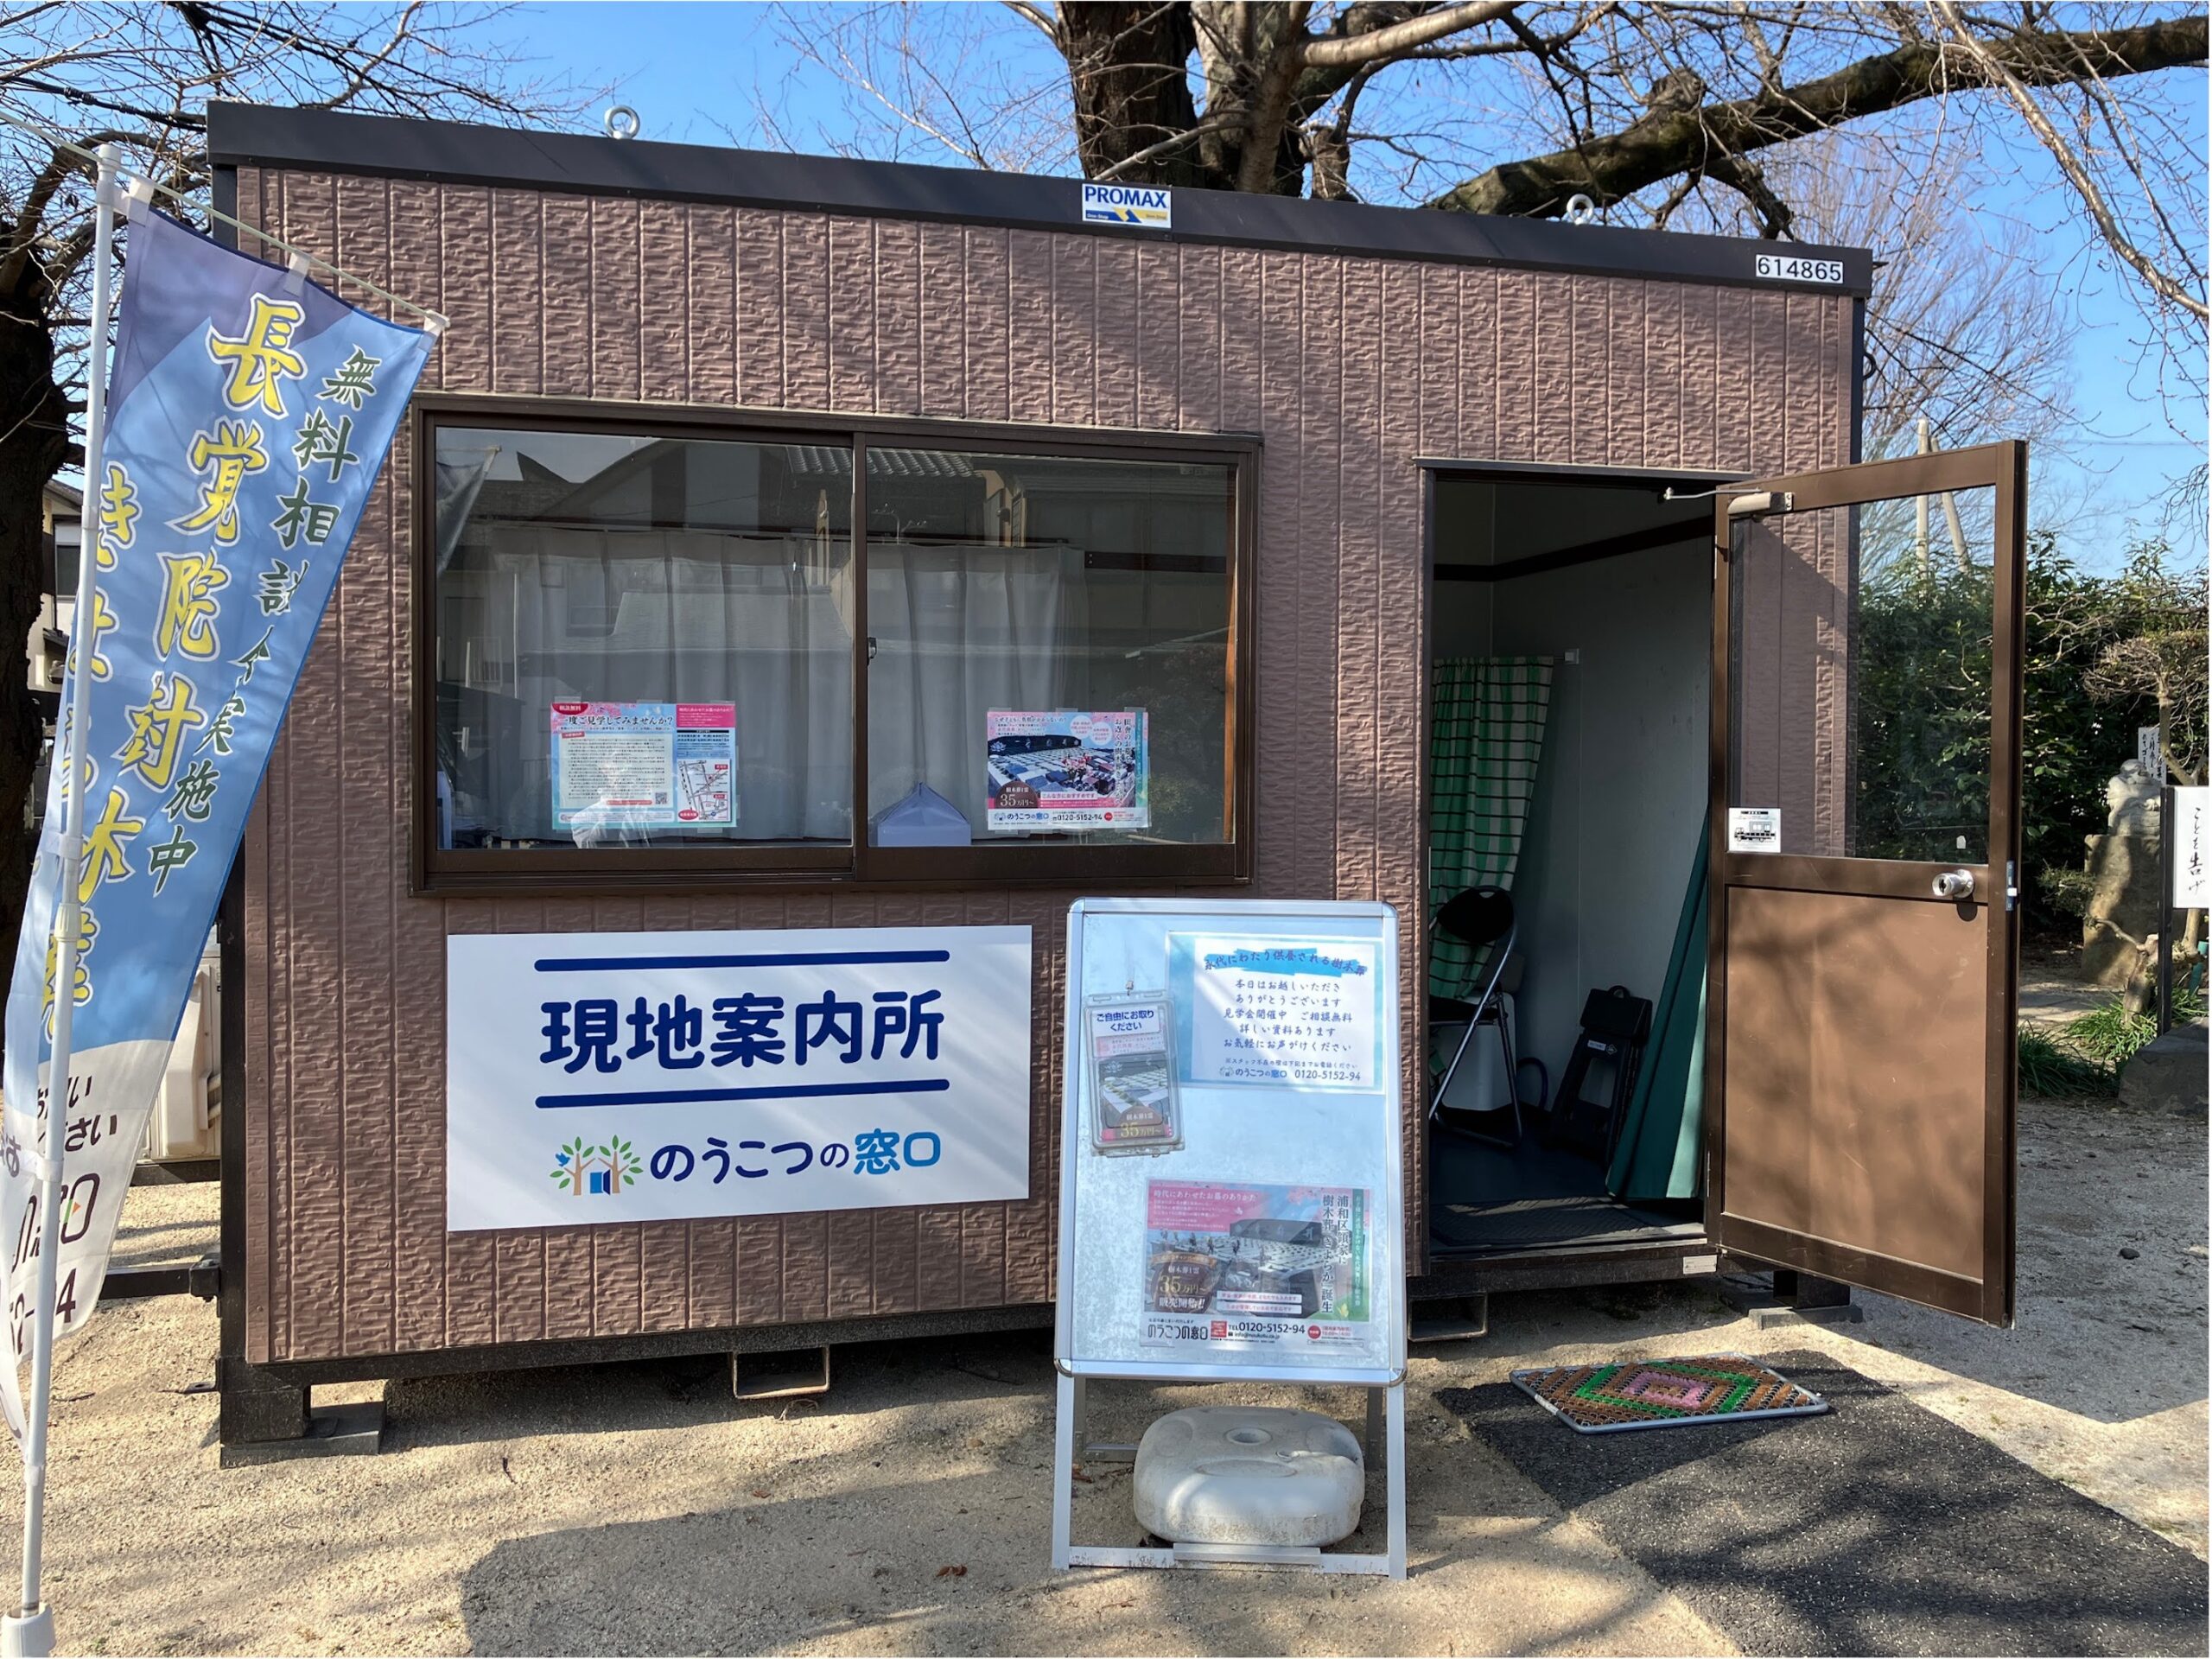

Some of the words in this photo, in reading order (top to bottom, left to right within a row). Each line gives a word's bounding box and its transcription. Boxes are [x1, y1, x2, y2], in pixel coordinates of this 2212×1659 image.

[1085, 186, 1167, 208] PROMAX
[1758, 257, 1841, 282] 614865
[1235, 979, 1341, 992] 本日はお越しいただき
[1235, 995, 1342, 1007] ありがとうございます
[1096, 1009, 1154, 1022] ご自由にお取り
[1224, 1009, 1287, 1020] 見学会開催中
[1300, 1011, 1353, 1023] ご相談無料
[540, 988, 945, 1074] 現地案内所
[1109, 1021, 1143, 1032] ください
[1239, 1023, 1336, 1037] 詳しい資料あります
[1224, 1038, 1352, 1052] お気軽にお声がけください
[1235, 1067, 1287, 1078] のうこつの窓口
[1294, 1069, 1362, 1081] 0120-5152-94
[650, 1128, 942, 1185] のうこつの窓口
[1147, 1324, 1208, 1340] のうこつの窓口
[1238, 1321, 1306, 1334] 0120-5152-94
